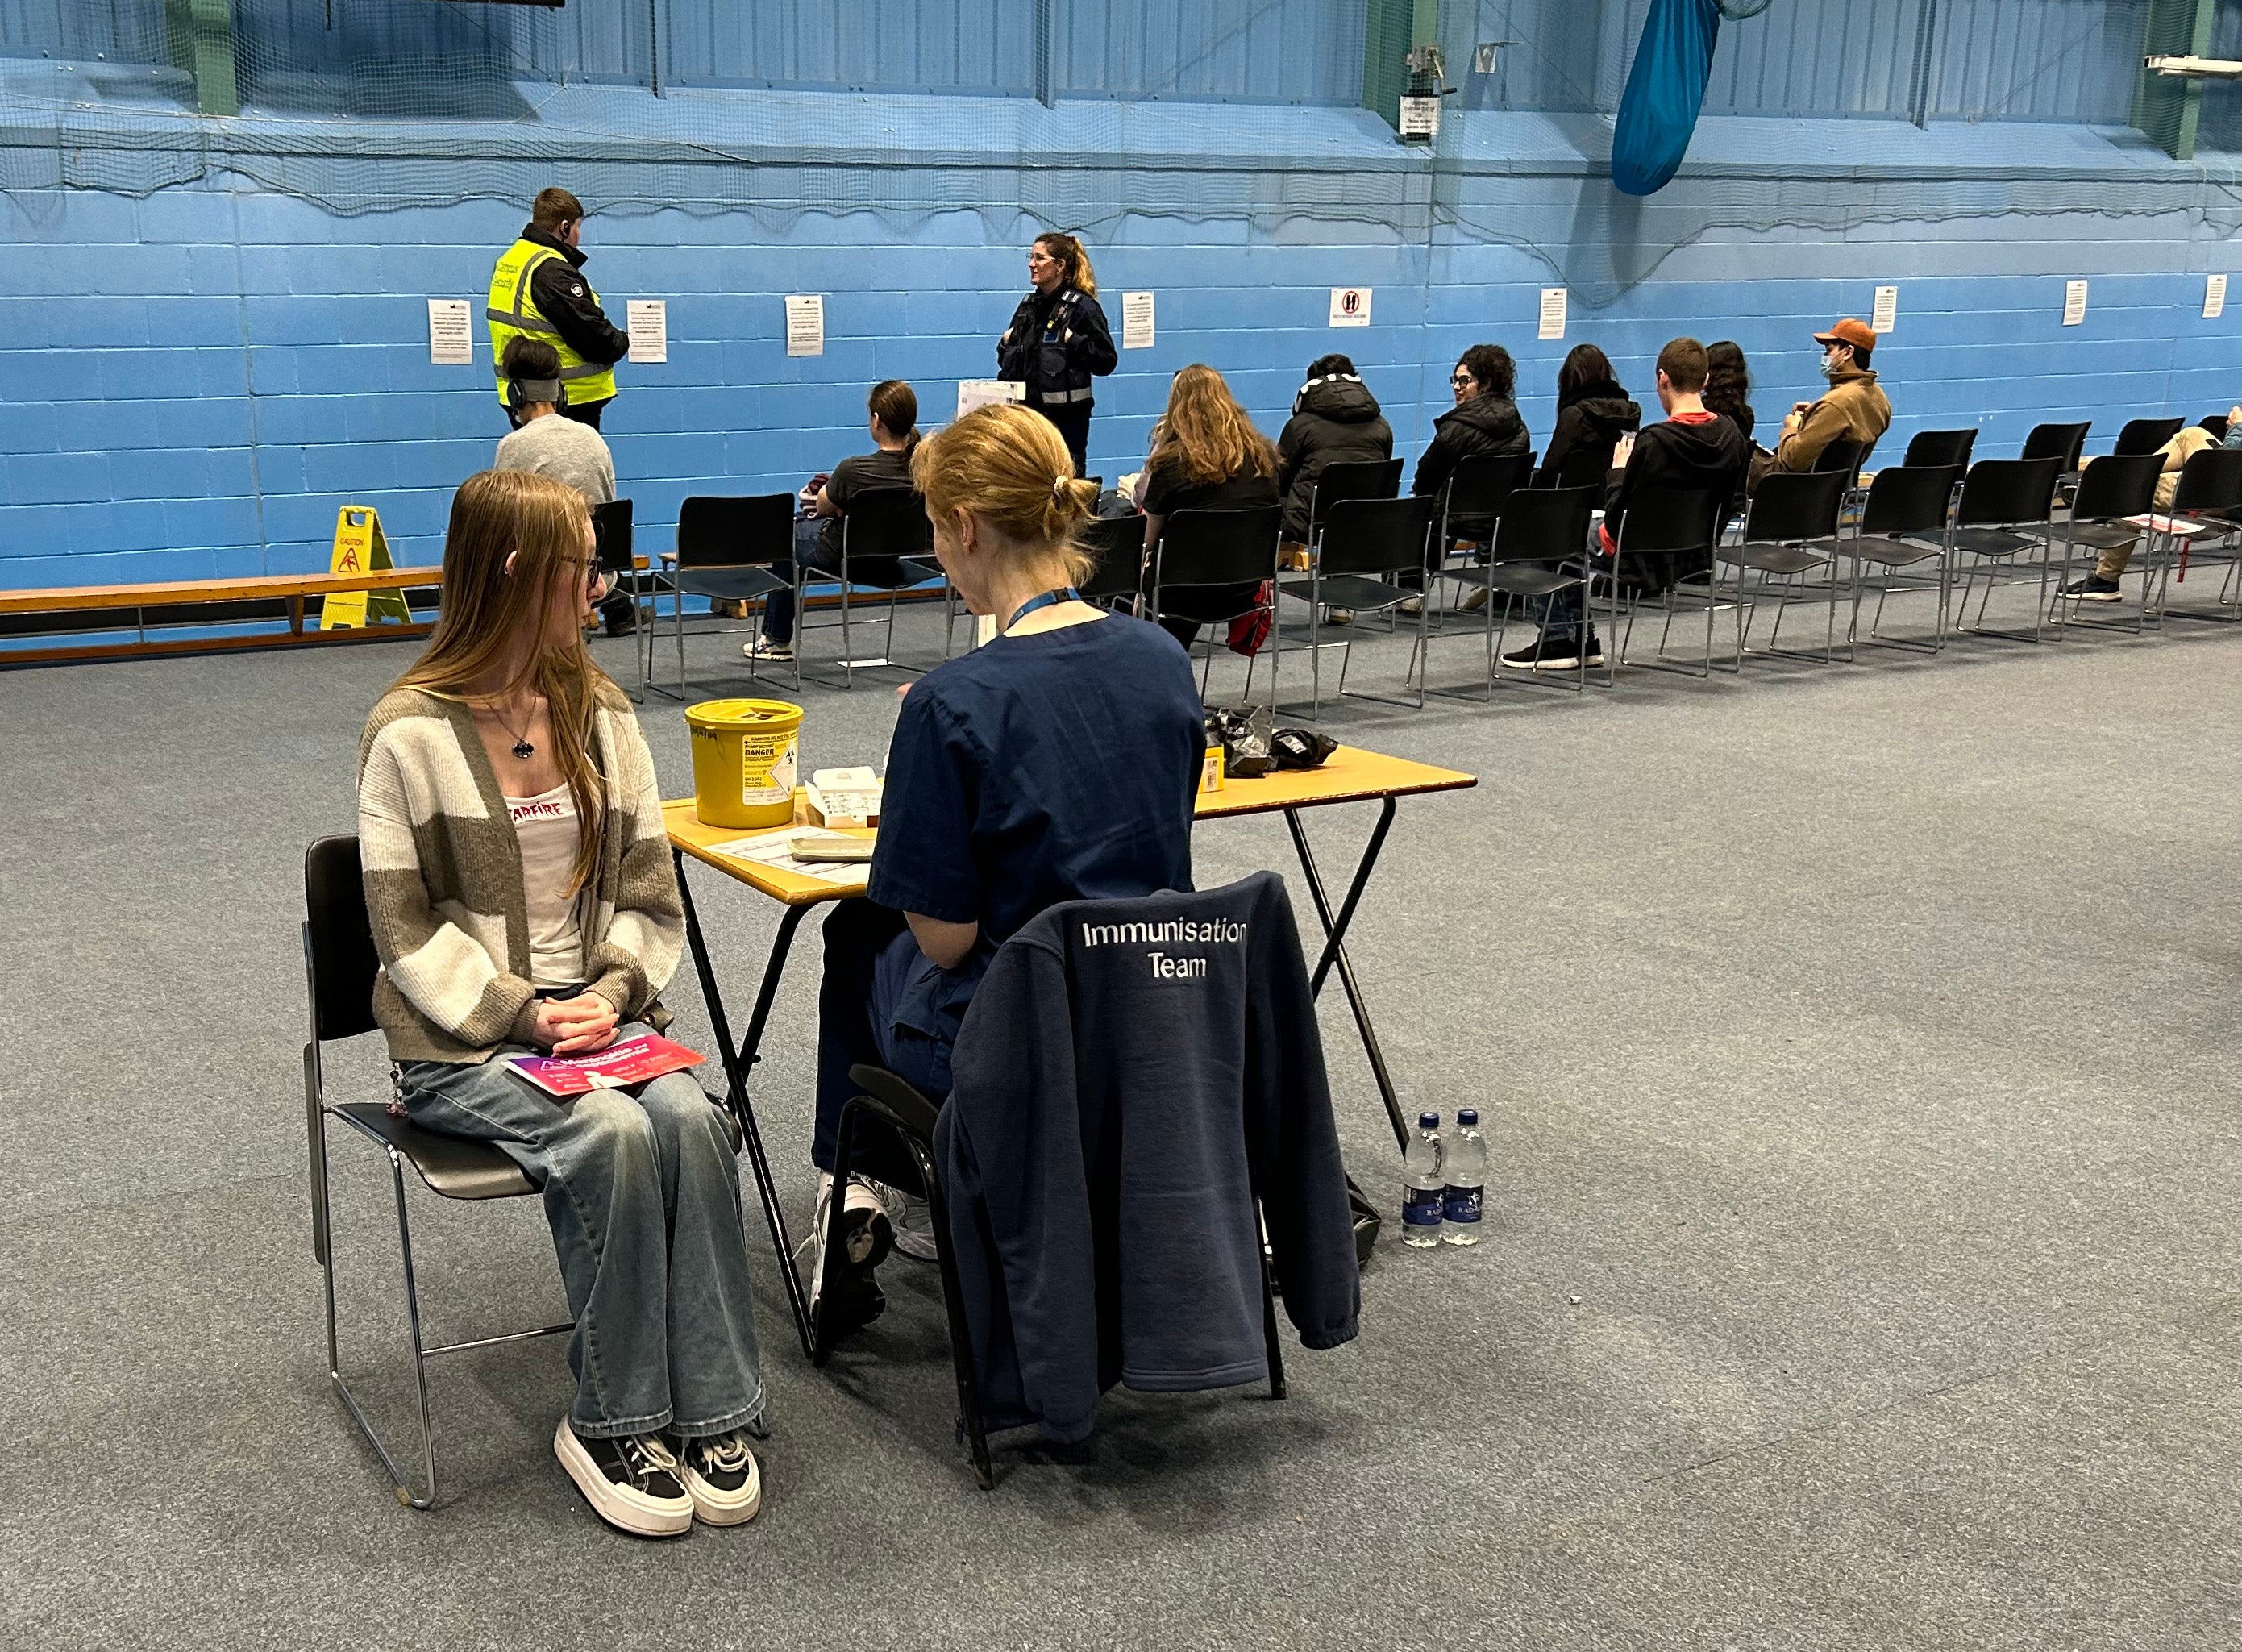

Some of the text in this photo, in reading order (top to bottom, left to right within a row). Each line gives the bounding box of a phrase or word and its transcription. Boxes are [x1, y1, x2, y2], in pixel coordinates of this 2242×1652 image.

[339, 537, 364, 546] CAUTION
[745, 748, 774, 756] DANGER
[509, 801, 564, 822] ARFIRE
[1082, 917, 1246, 947] Immunisation
[1147, 952, 1207, 978] Team
